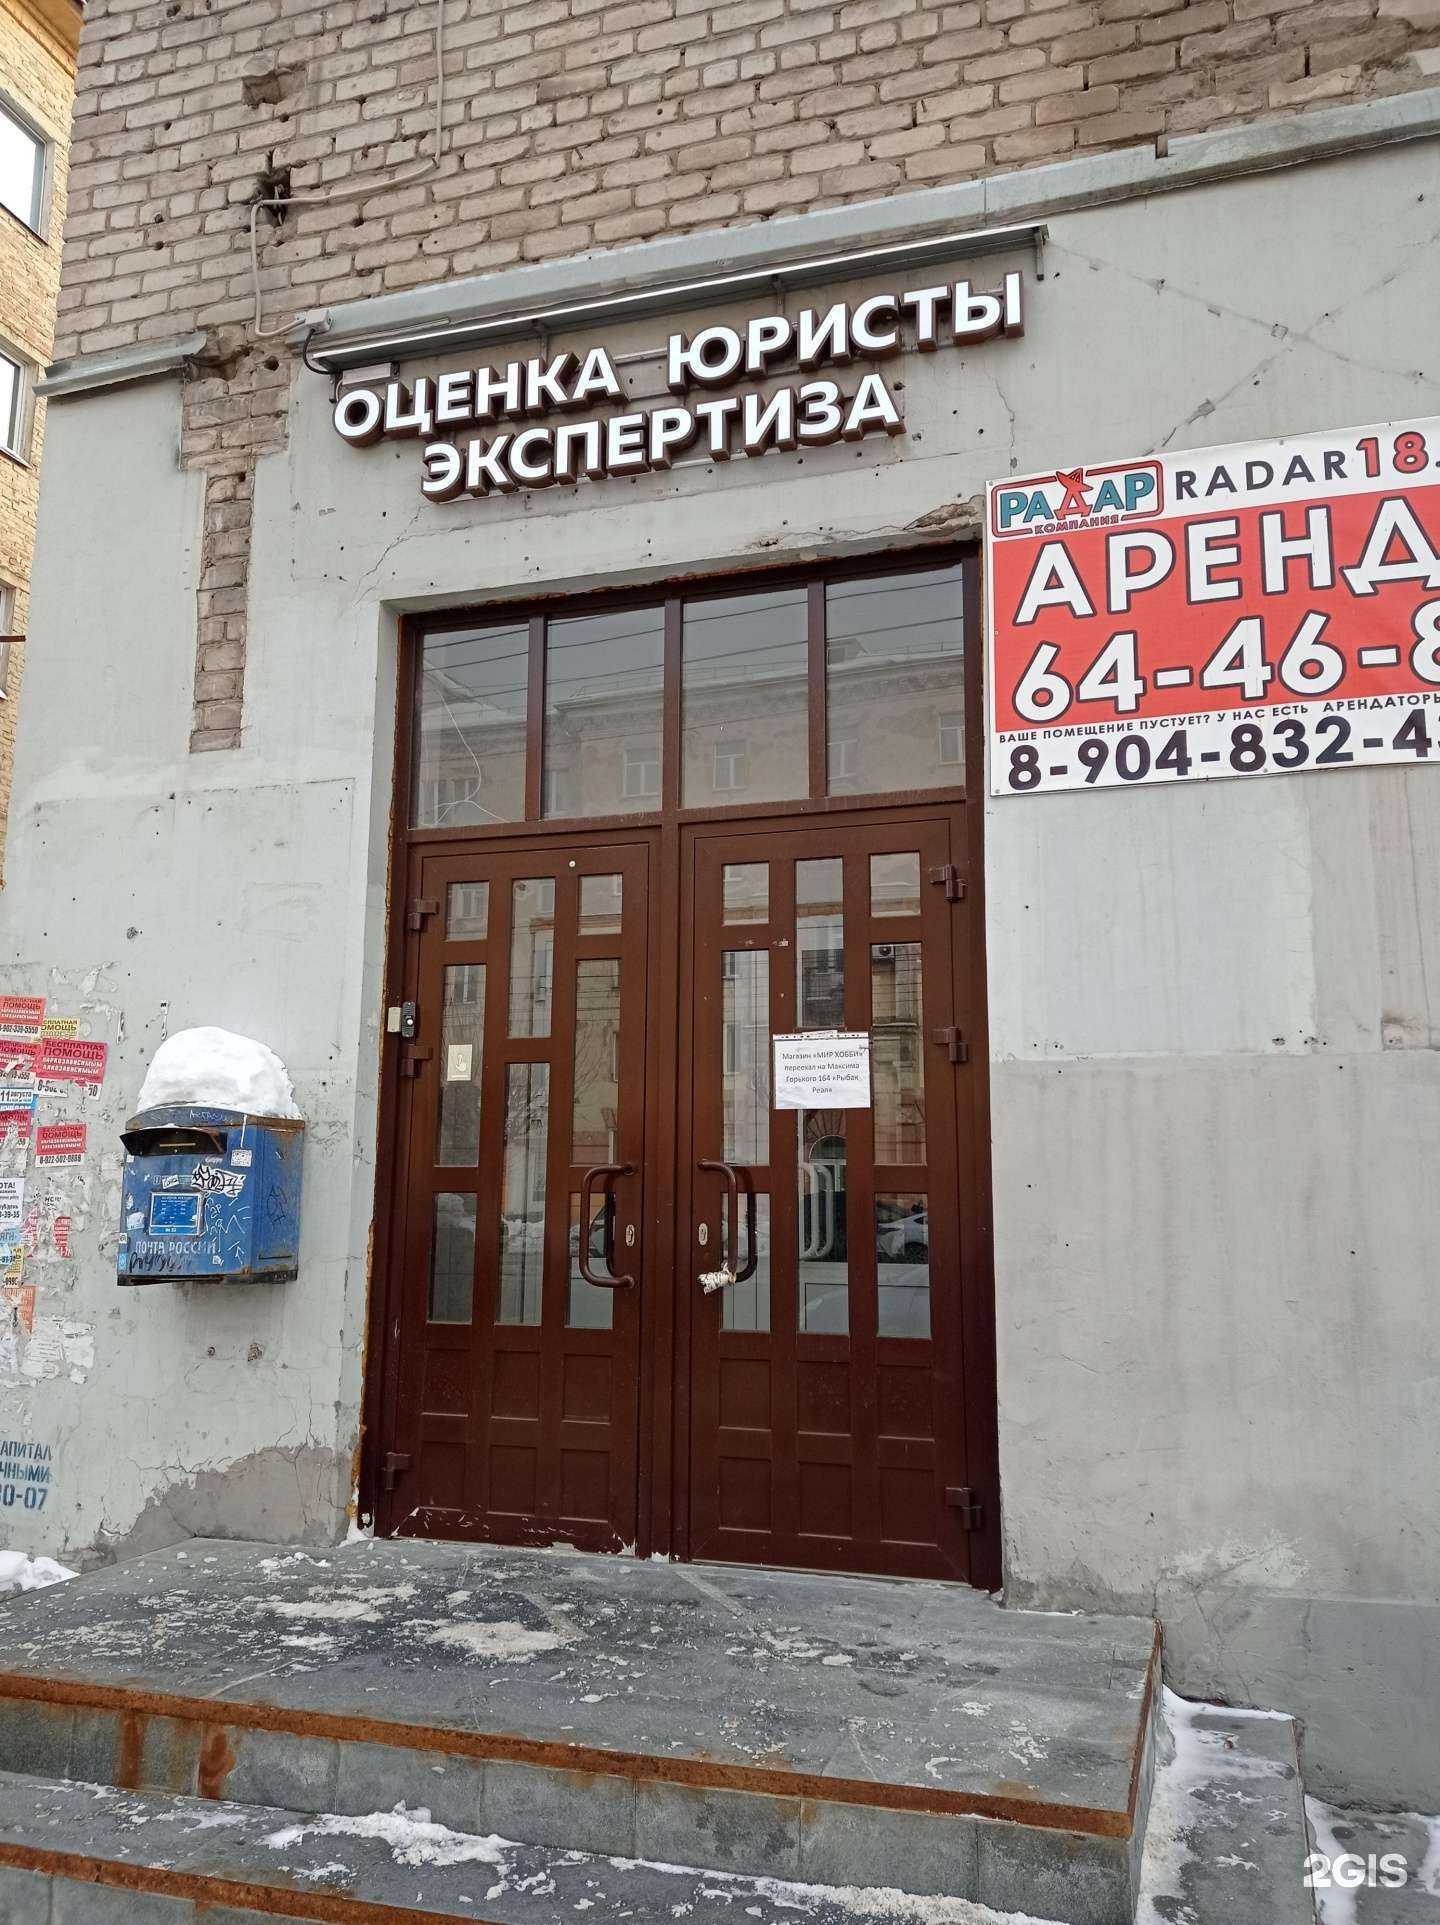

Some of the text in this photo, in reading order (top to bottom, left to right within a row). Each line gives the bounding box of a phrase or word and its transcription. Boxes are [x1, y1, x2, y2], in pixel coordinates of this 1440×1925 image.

[333, 271, 1024, 443] ОЦЕНКА ЮРИСТЫ
[420, 372, 906, 498] ЭКСПЕРТИЗА
[1000, 468, 1155, 529] РАДАР
[1034, 514, 1120, 535] КОМПАНИЯ
[999, 731, 1038, 744] ВАШЕ
[1043, 723, 1134, 740] ПОМЕЩЕНИЕ
[1139, 714, 1211, 730] ПУСТУЕТ?
[1217, 712, 1226, 722] У
[1233, 709, 1265, 721] НАС
[1272, 704, 1309, 717] ЕСТЬ
[1008, 708, 1440, 791] 8-904-832-4
[43, 1046, 104, 1061] ПОМОЩЬ
[45, 1041, 105, 1051] БЕСПЛАТНАЯ
[784, 1064, 816, 1072] переехал
[827, 1062, 860, 1070] Максима
[786, 1075, 817, 1083] Горького
[135, 1241, 165, 1255] ПОЧТА
